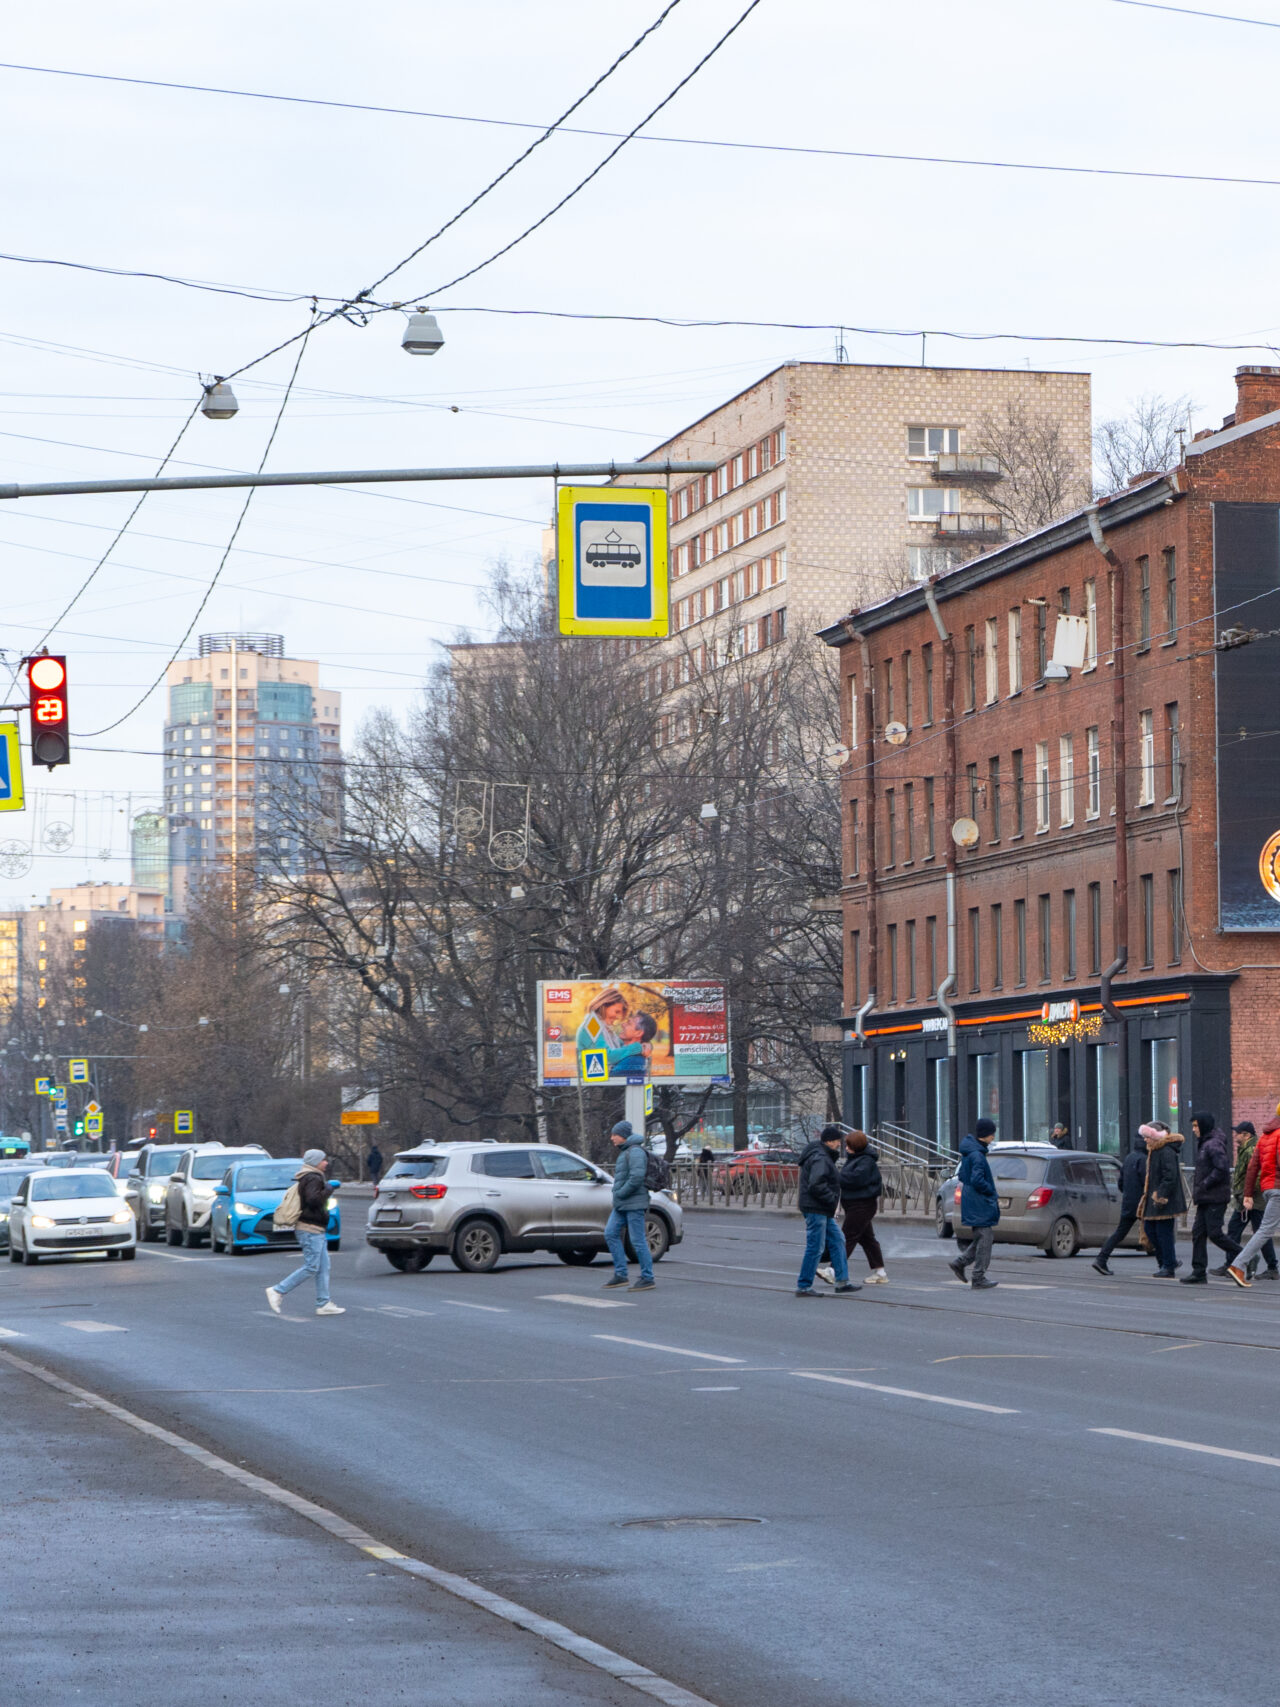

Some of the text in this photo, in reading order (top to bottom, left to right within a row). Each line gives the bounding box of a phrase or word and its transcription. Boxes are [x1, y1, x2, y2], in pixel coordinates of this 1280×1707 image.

[37, 699, 63, 721] 23
[548, 991, 571, 999] EMS
[922, 1017, 948, 1032] УНИВЕРСА
